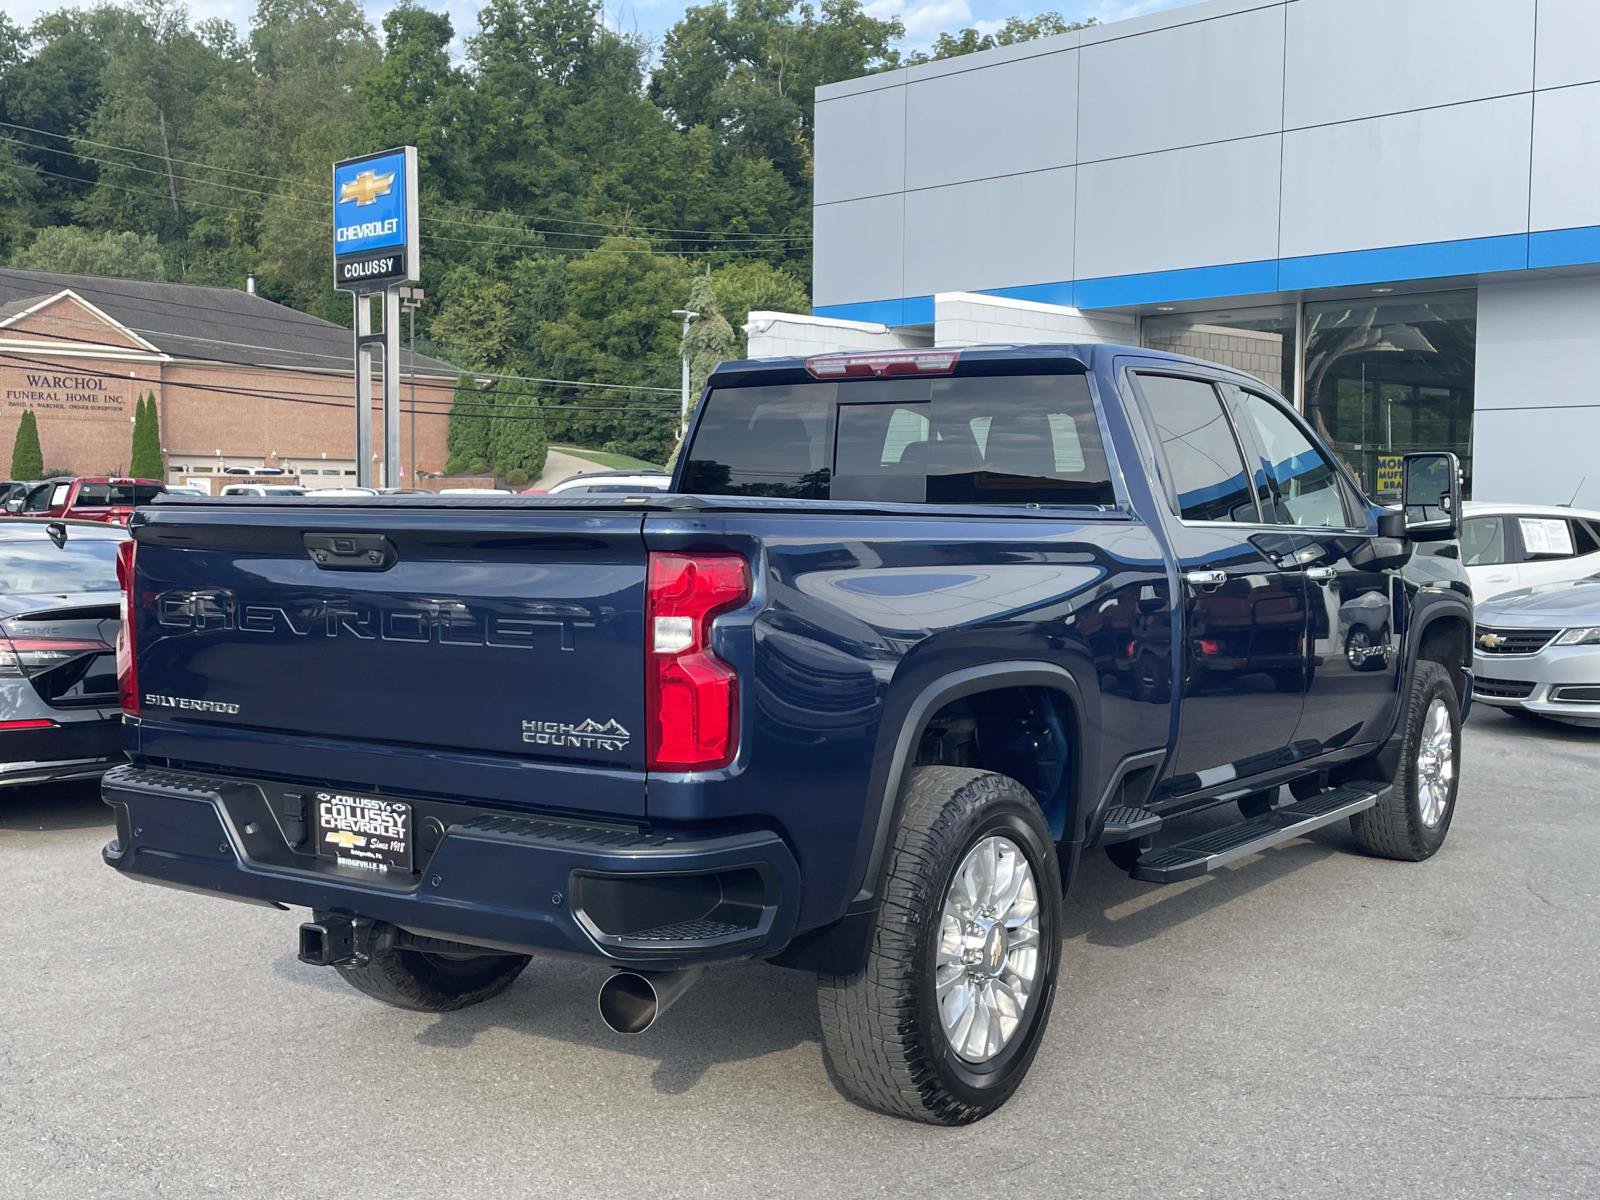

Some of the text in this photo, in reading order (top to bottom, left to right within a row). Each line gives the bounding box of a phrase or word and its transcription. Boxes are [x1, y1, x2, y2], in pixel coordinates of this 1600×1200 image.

[337, 218, 398, 242] CHEVROLET
[344, 258, 394, 278] COLUSSY
[26, 374, 107, 390] WARCHOL
[7, 390, 60, 401] FUNERAL
[66, 393, 98, 403] HOME
[154, 588, 597, 652] CHEVROLET
[145, 693, 241, 714] SILVERADO
[522, 719, 575, 735] HIGH
[522, 732, 630, 751] COUNTRY
[335, 795, 388, 811] COLUSSY
[320, 802, 407, 828] COLUSSY
[320, 816, 406, 839] CHEVROLET
[369, 838, 406, 853] Since 1918
